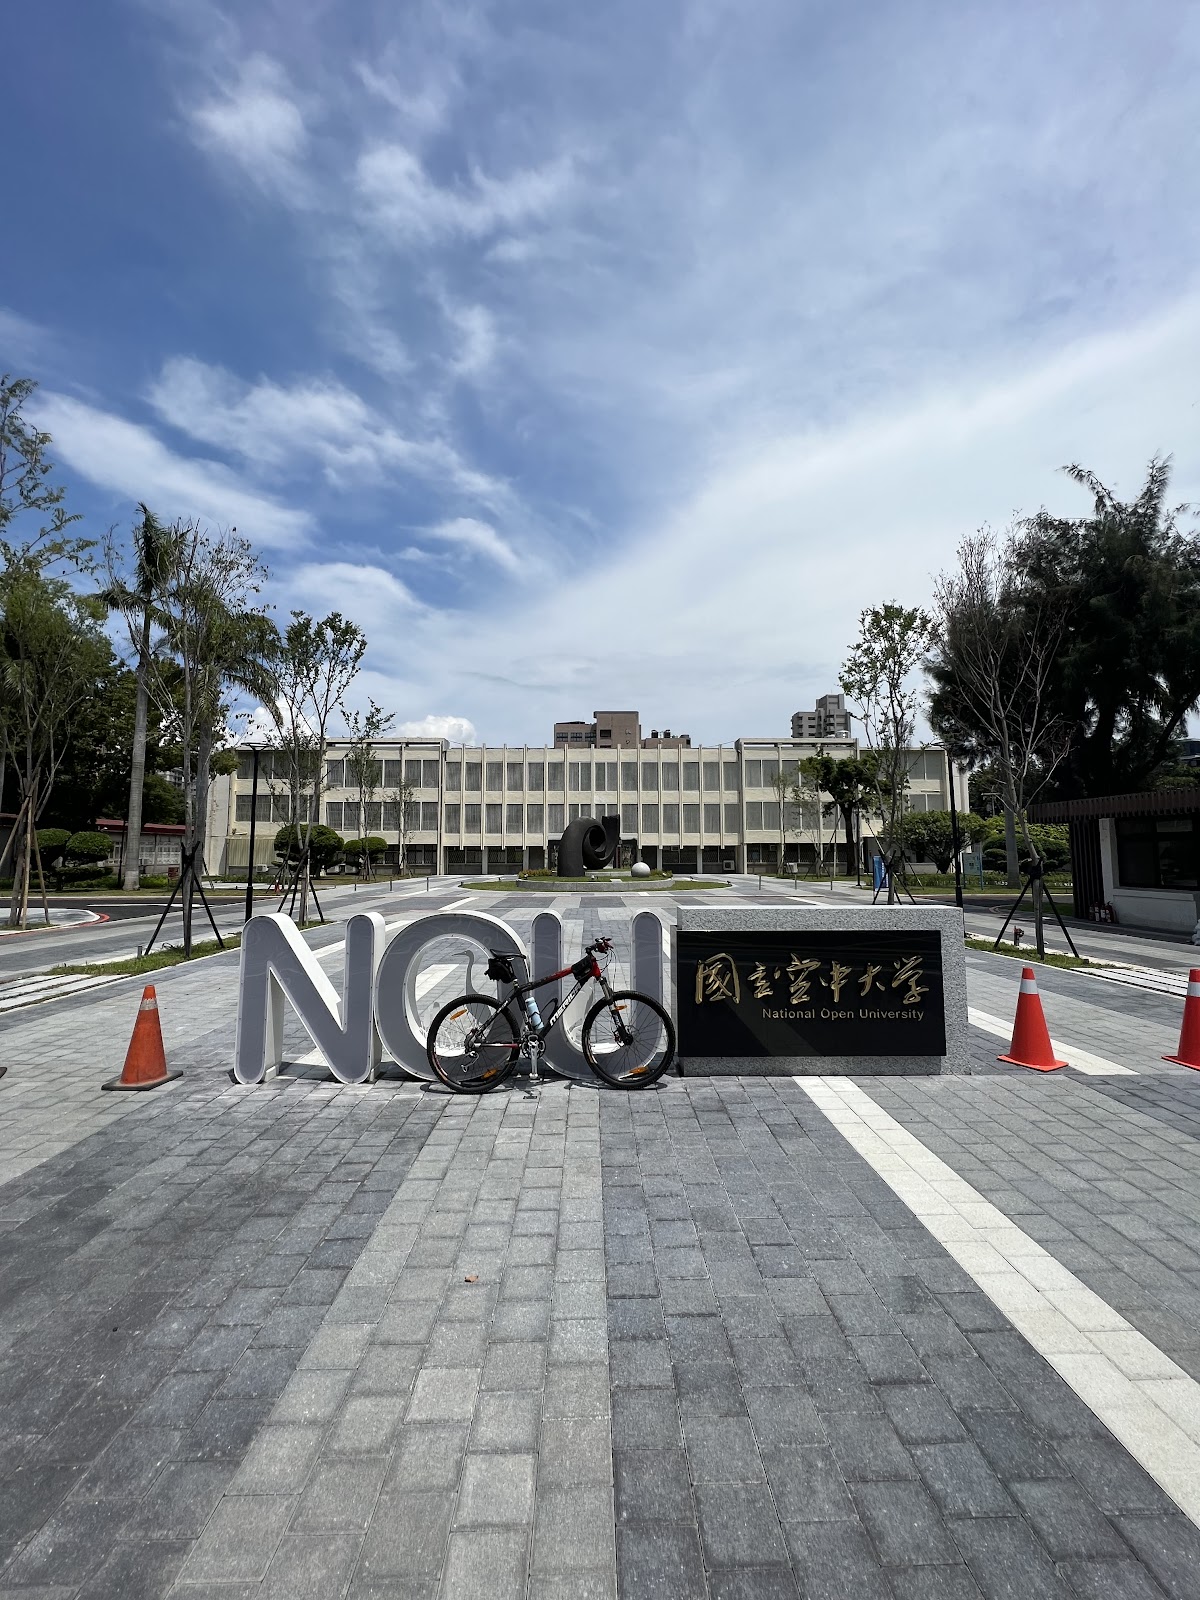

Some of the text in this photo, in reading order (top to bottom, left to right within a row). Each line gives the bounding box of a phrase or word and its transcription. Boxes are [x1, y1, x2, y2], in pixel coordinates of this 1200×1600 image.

[234, 911, 664, 1085] NOU
[762, 1008, 924, 1021] National Open University
